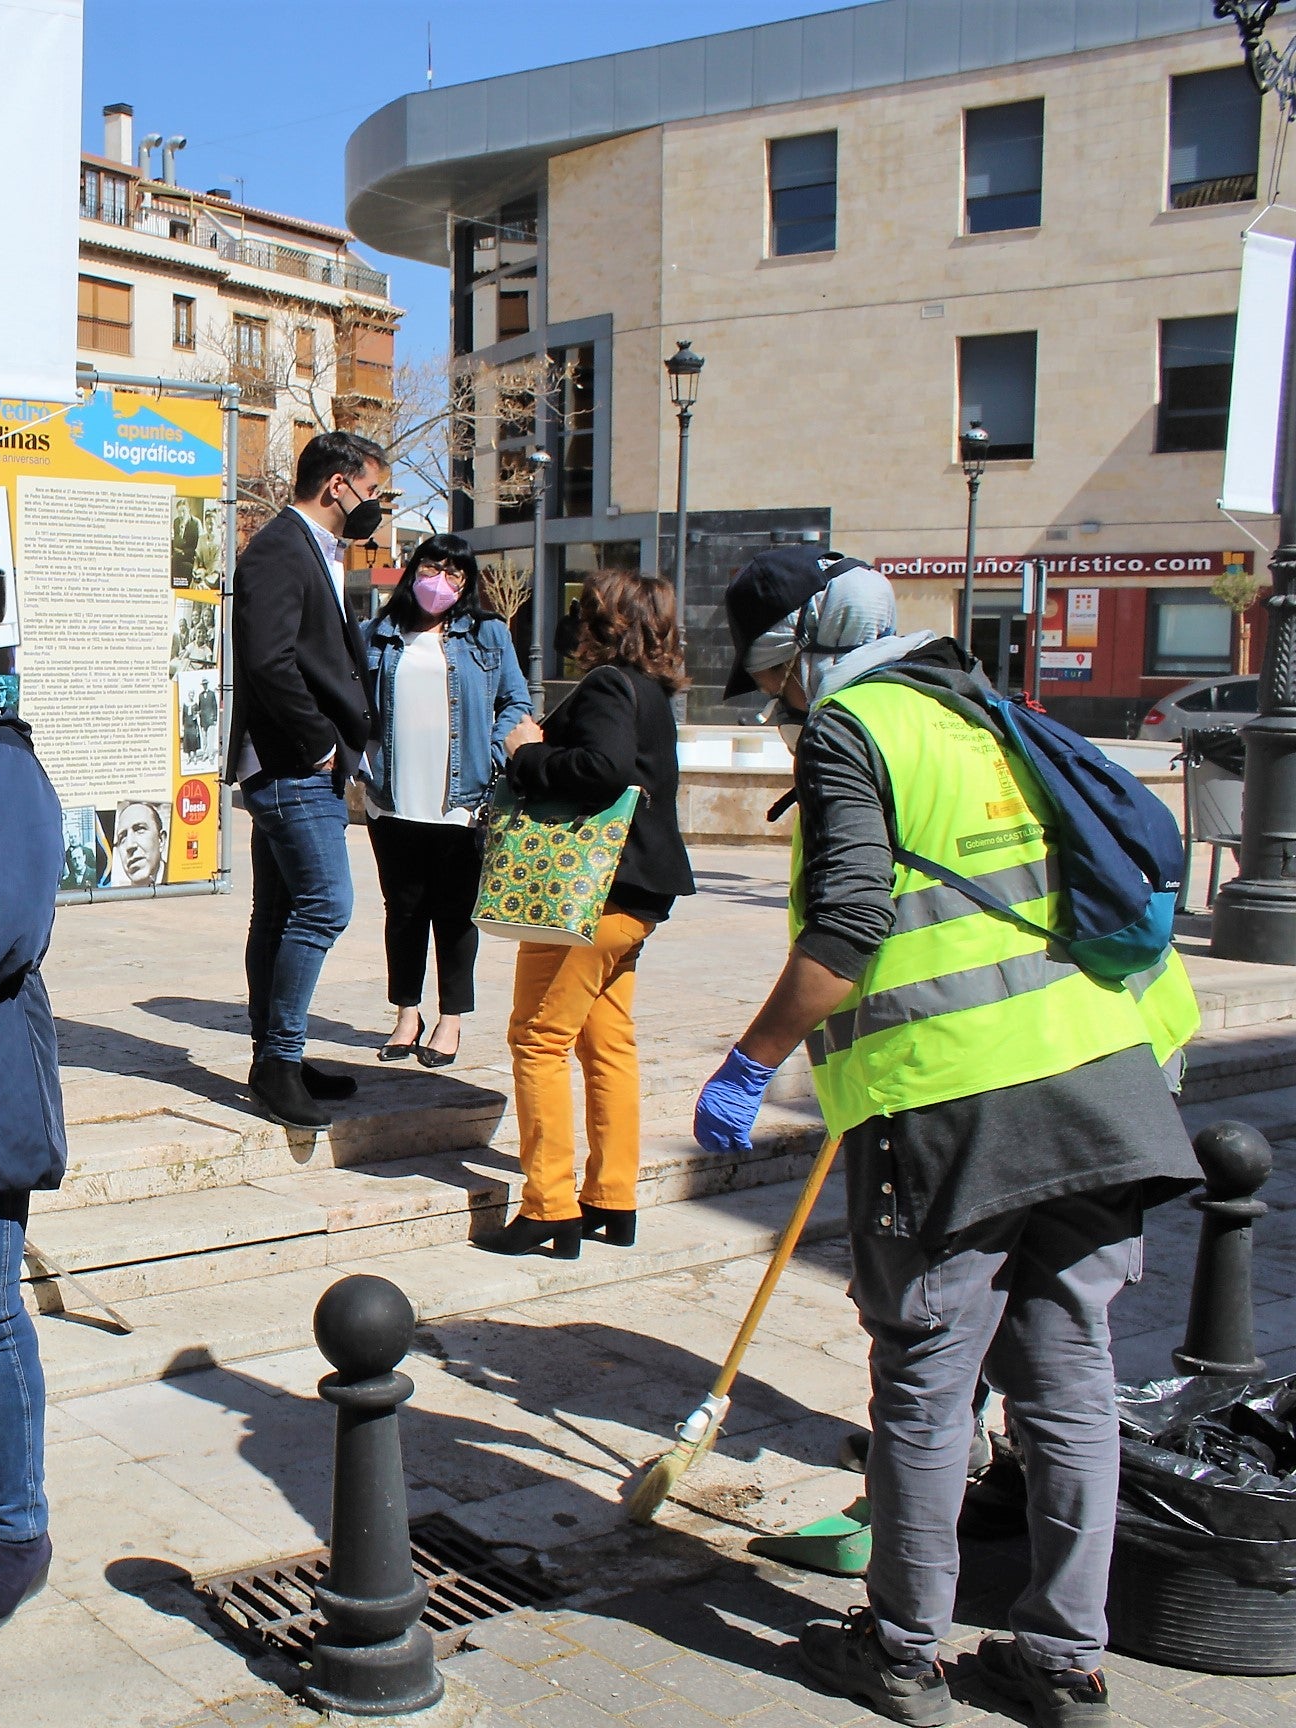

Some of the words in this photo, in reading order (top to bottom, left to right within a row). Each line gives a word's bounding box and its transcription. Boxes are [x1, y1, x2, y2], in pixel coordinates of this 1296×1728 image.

[117, 424, 184, 442] apuntes
[2, 454, 51, 466] aniversario
[104, 442, 196, 466] biográficos
[183, 782, 203, 798] DÍA
